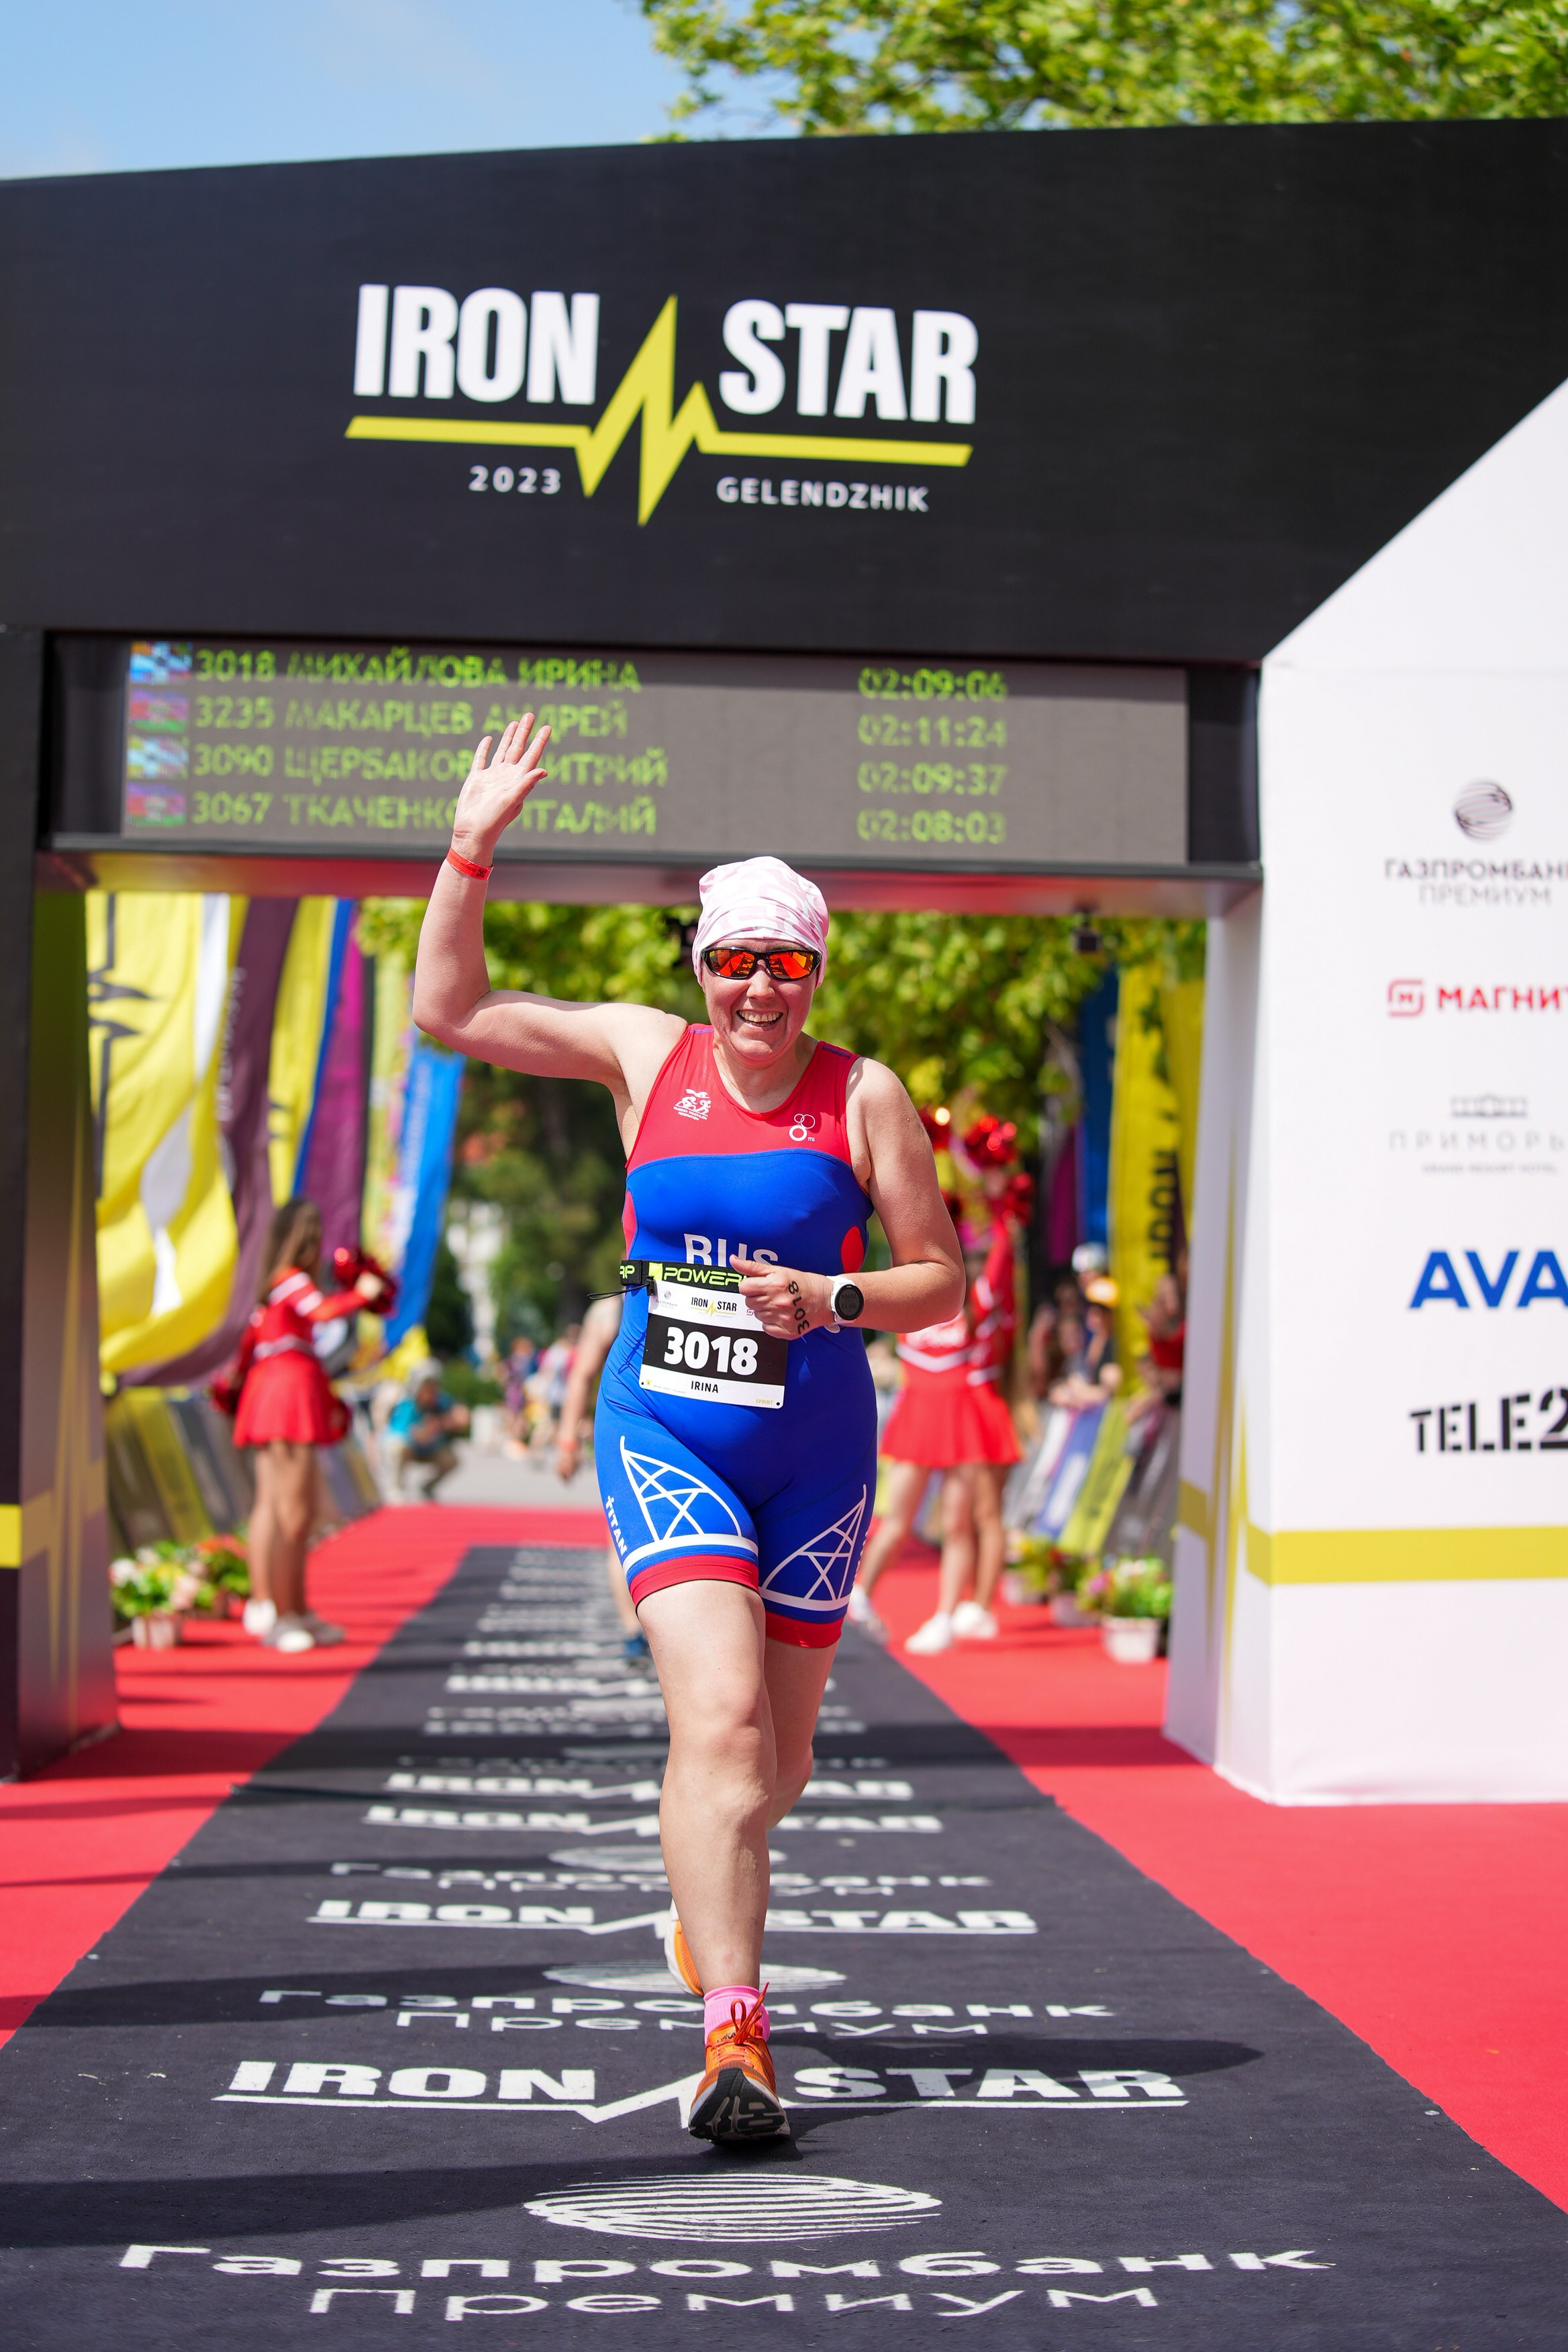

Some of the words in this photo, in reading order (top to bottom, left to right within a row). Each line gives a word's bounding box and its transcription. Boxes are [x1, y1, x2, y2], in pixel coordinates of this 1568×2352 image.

[352, 284, 601, 404] IRON
[718, 299, 979, 424] STAR
[469, 465, 562, 494] 2023
[716, 477, 930, 511] GELENDZHIK
[197, 649, 277, 683] 3018
[518, 655, 642, 693] ИРИНА
[857, 667, 1008, 702] 02:09:06
[195, 695, 276, 729] 3235
[856, 712, 1007, 748] 02:11:24
[194, 742, 275, 777] 3090
[856, 761, 1008, 796] 02:09:37
[192, 791, 273, 826] 3067
[856, 808, 1007, 844] 02:08:03
[1419, 883, 1553, 906] ПРЕМИУМ
[1438, 987, 1568, 1011] МАГНИ
[664, 1267, 746, 1286] POWER
[1410, 1251, 1568, 1308] AVA
[691, 1297, 708, 1308] IRON
[717, 1301, 737, 1312] STAR
[788, 1281, 810, 1334] 3018
[664, 1326, 758, 1375] 3018
[691, 1381, 718, 1393] IRINA
[1410, 1387, 1568, 1451] TELE2
[605, 1496, 628, 1556] TITAN
[317, 1900, 594, 1924] IRON
[229, 2061, 595, 2100] IRON
[793, 2067, 1185, 2098] STAR
[119, 2245, 1337, 2283] Газпромбанк
[309, 2287, 1159, 2321] Премиум
